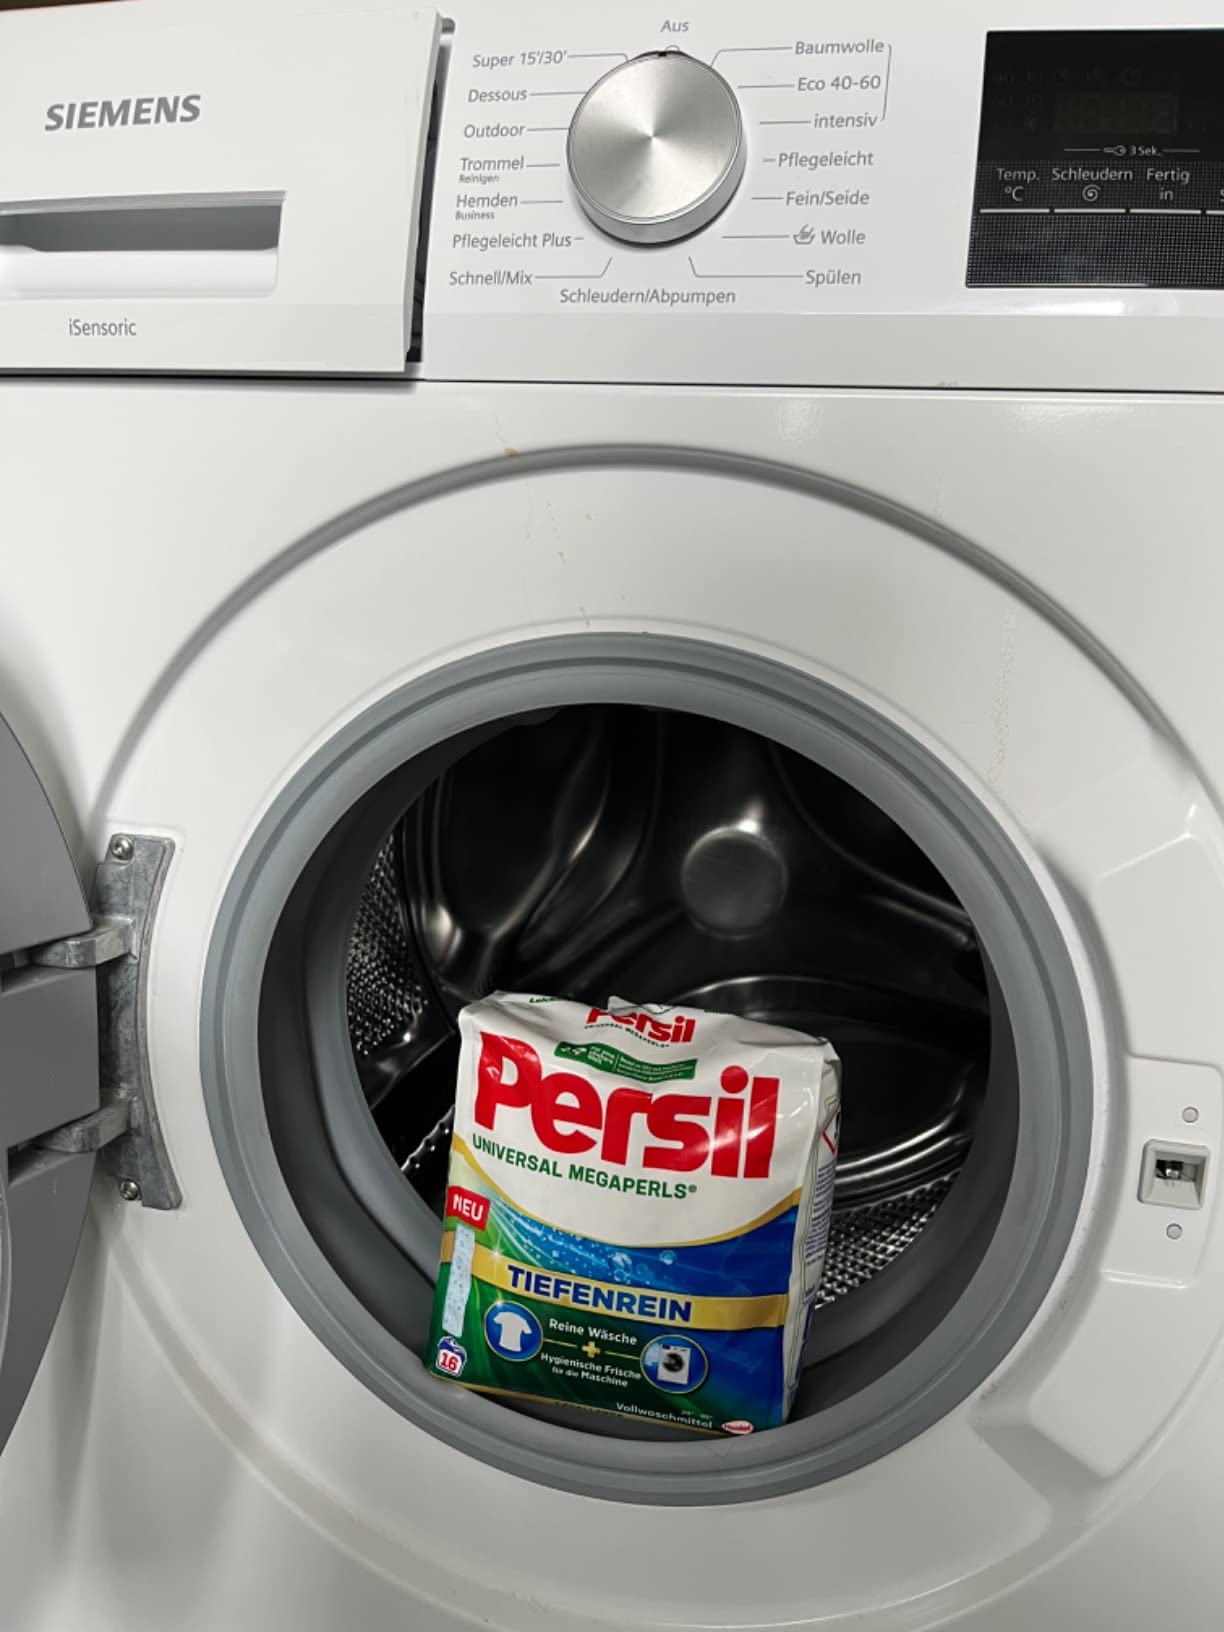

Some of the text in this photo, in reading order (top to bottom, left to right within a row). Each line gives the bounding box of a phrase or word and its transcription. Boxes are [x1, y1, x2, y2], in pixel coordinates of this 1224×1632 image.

[661, 19, 690, 33] Aus
[795, 38, 885, 55] Baumwolle
[473, 54, 515, 70] Super
[798, 75, 881, 91] Eco 40-60
[468, 88, 528, 103] Dessous
[44, 94, 201, 131] SIEMENS
[814, 112, 878, 129] intensiv
[464, 123, 526, 139] Outdoor
[460, 155, 525, 172] Trommel
[778, 150, 874, 171] Pflegeleicht
[997, 167, 1191, 185] Temp. Schleudern Fertig
[456, 194, 518, 208] Hemden
[785, 190, 870, 207] Fein/Seide
[1159, 187, 1174, 201] in
[455, 210, 495, 221] Business
[453, 232, 572, 252] Pflegeleicht Plus
[820, 229, 867, 246] Wolle
[449, 270, 533, 286] Schnell/Mix
[805, 269, 862, 287] Spülen
[560, 288, 737, 307] Schleudern/Abpumpen
[68, 318, 137, 337] iSensoric
[473, 1031, 781, 1180] Persil
[472, 1133, 563, 1178] UNIVERSAL
[452, 1193, 485, 1221] NEU
[507, 1264, 694, 1323] TIEFENREIN
[549, 1318, 638, 1346] Reine Wäsche
[440, 1352, 459, 1371] 16
[540, 1352, 642, 1381] Hygienische Frische
[580, 1371, 629, 1388] Maschine
[616, 1402, 713, 1430] Vollwaschmittel
